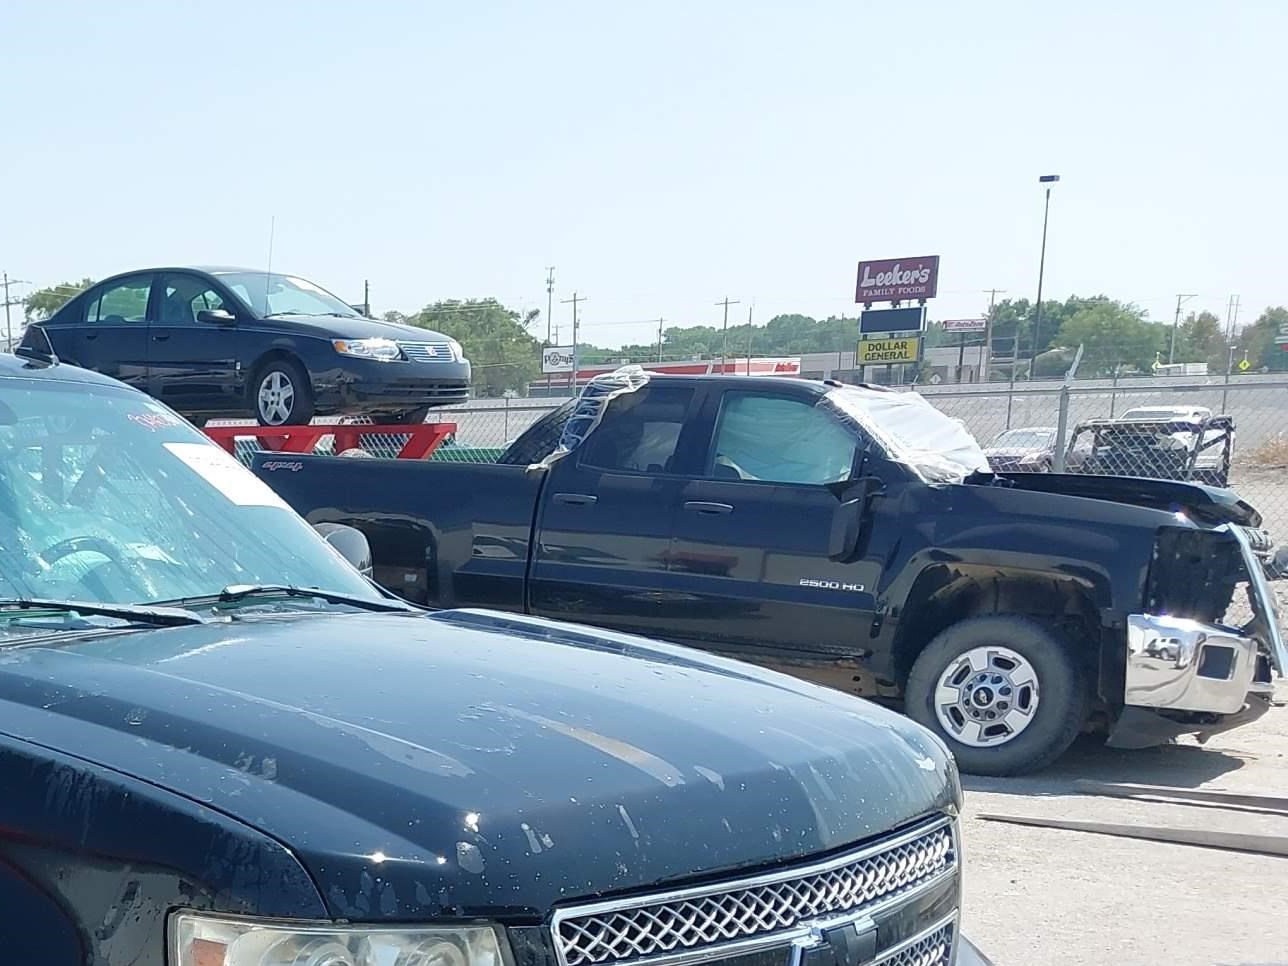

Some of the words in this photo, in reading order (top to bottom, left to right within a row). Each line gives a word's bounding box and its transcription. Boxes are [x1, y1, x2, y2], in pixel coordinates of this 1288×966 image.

[860, 263, 931, 288] Leeker's
[863, 287, 895, 297] FAMILY
[898, 285, 926, 295] FOODS
[867, 340, 908, 352] DOLLAR
[864, 350, 910, 361] GENERAL
[799, 577, 840, 590] 2500
[842, 582, 865, 592] HD
